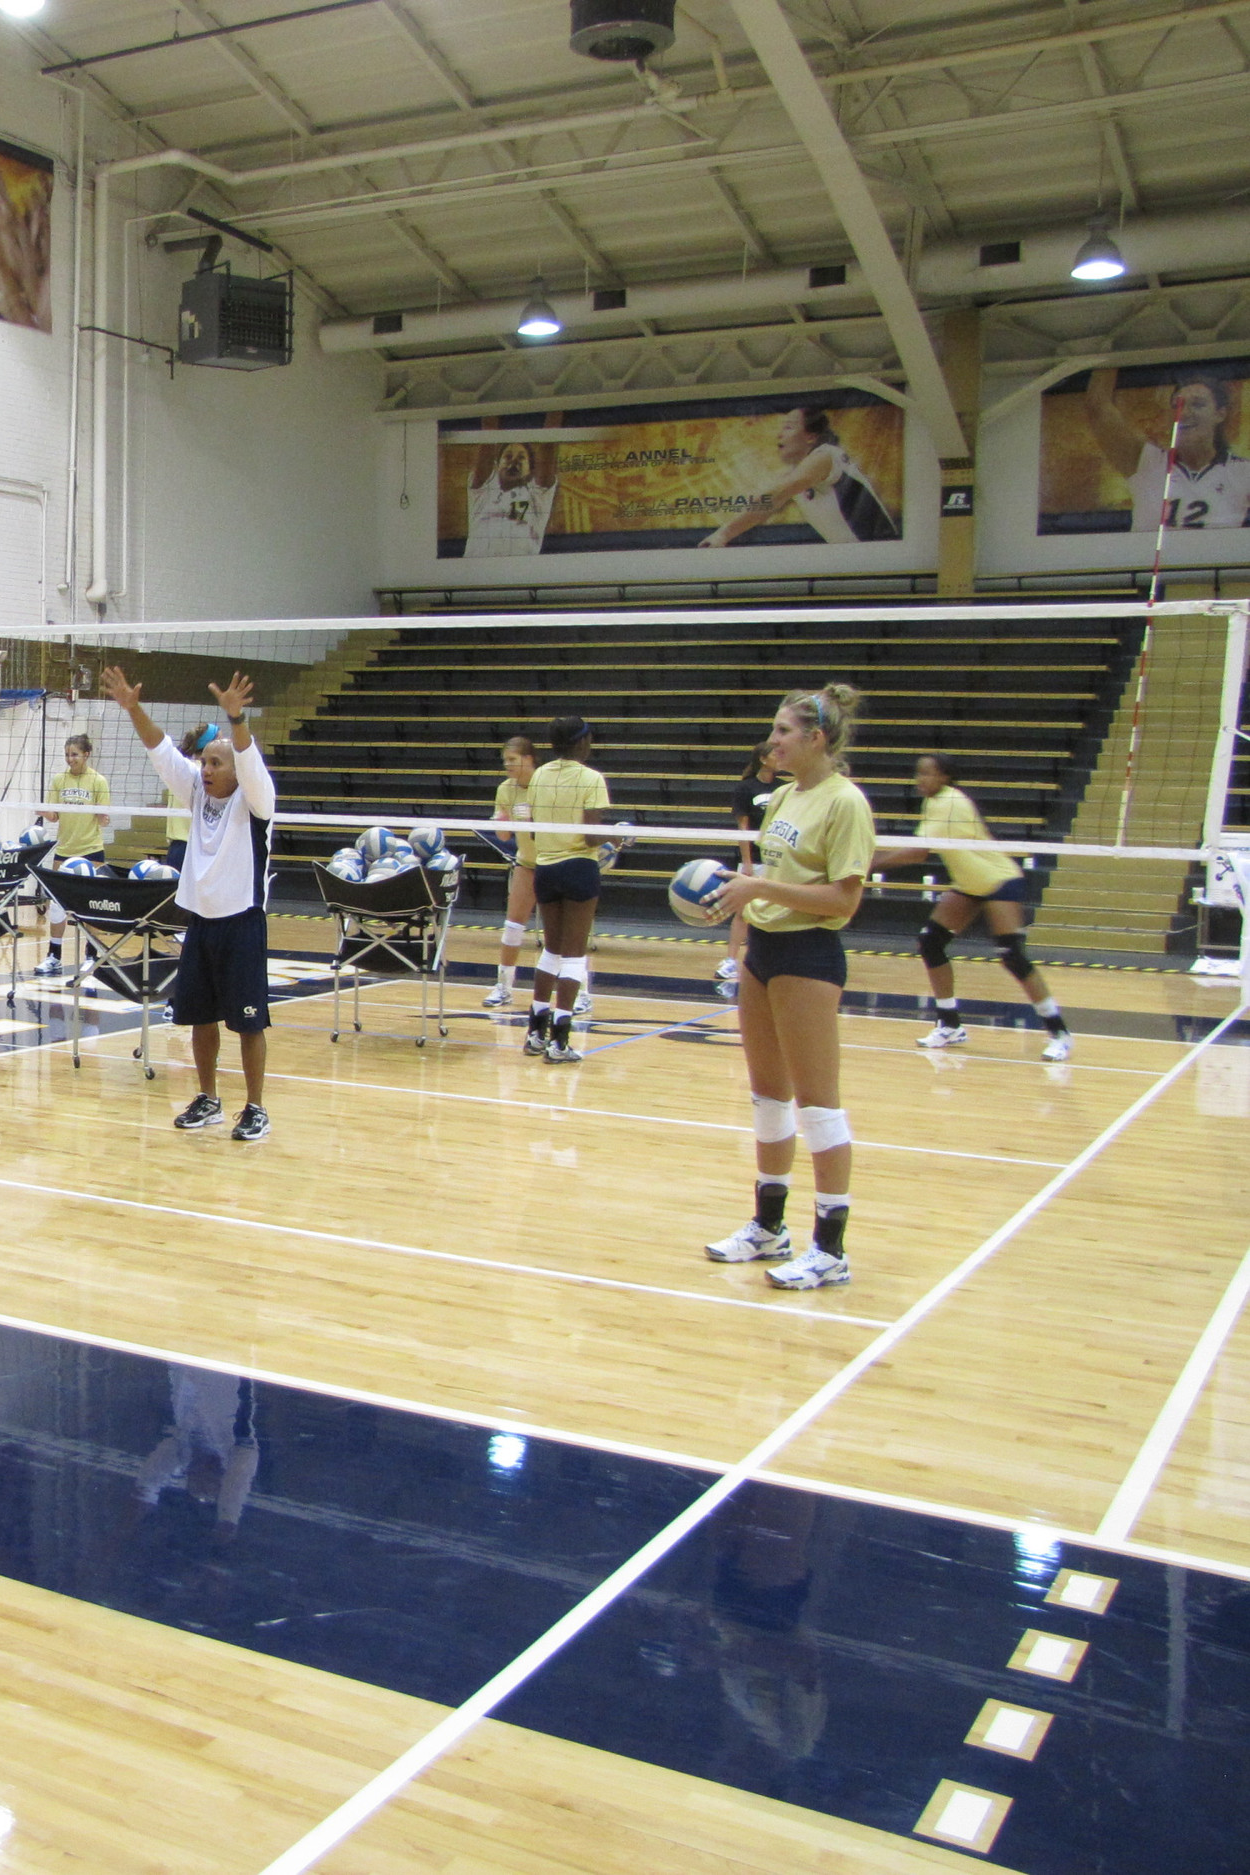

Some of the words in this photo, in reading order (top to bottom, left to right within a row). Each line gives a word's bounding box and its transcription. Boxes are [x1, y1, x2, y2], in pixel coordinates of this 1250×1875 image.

[625, 448, 692, 463] ANNEL
[674, 493, 774, 509] PACHALE
[1166, 499, 1209, 529] 12
[88, 899, 121, 913] molten
